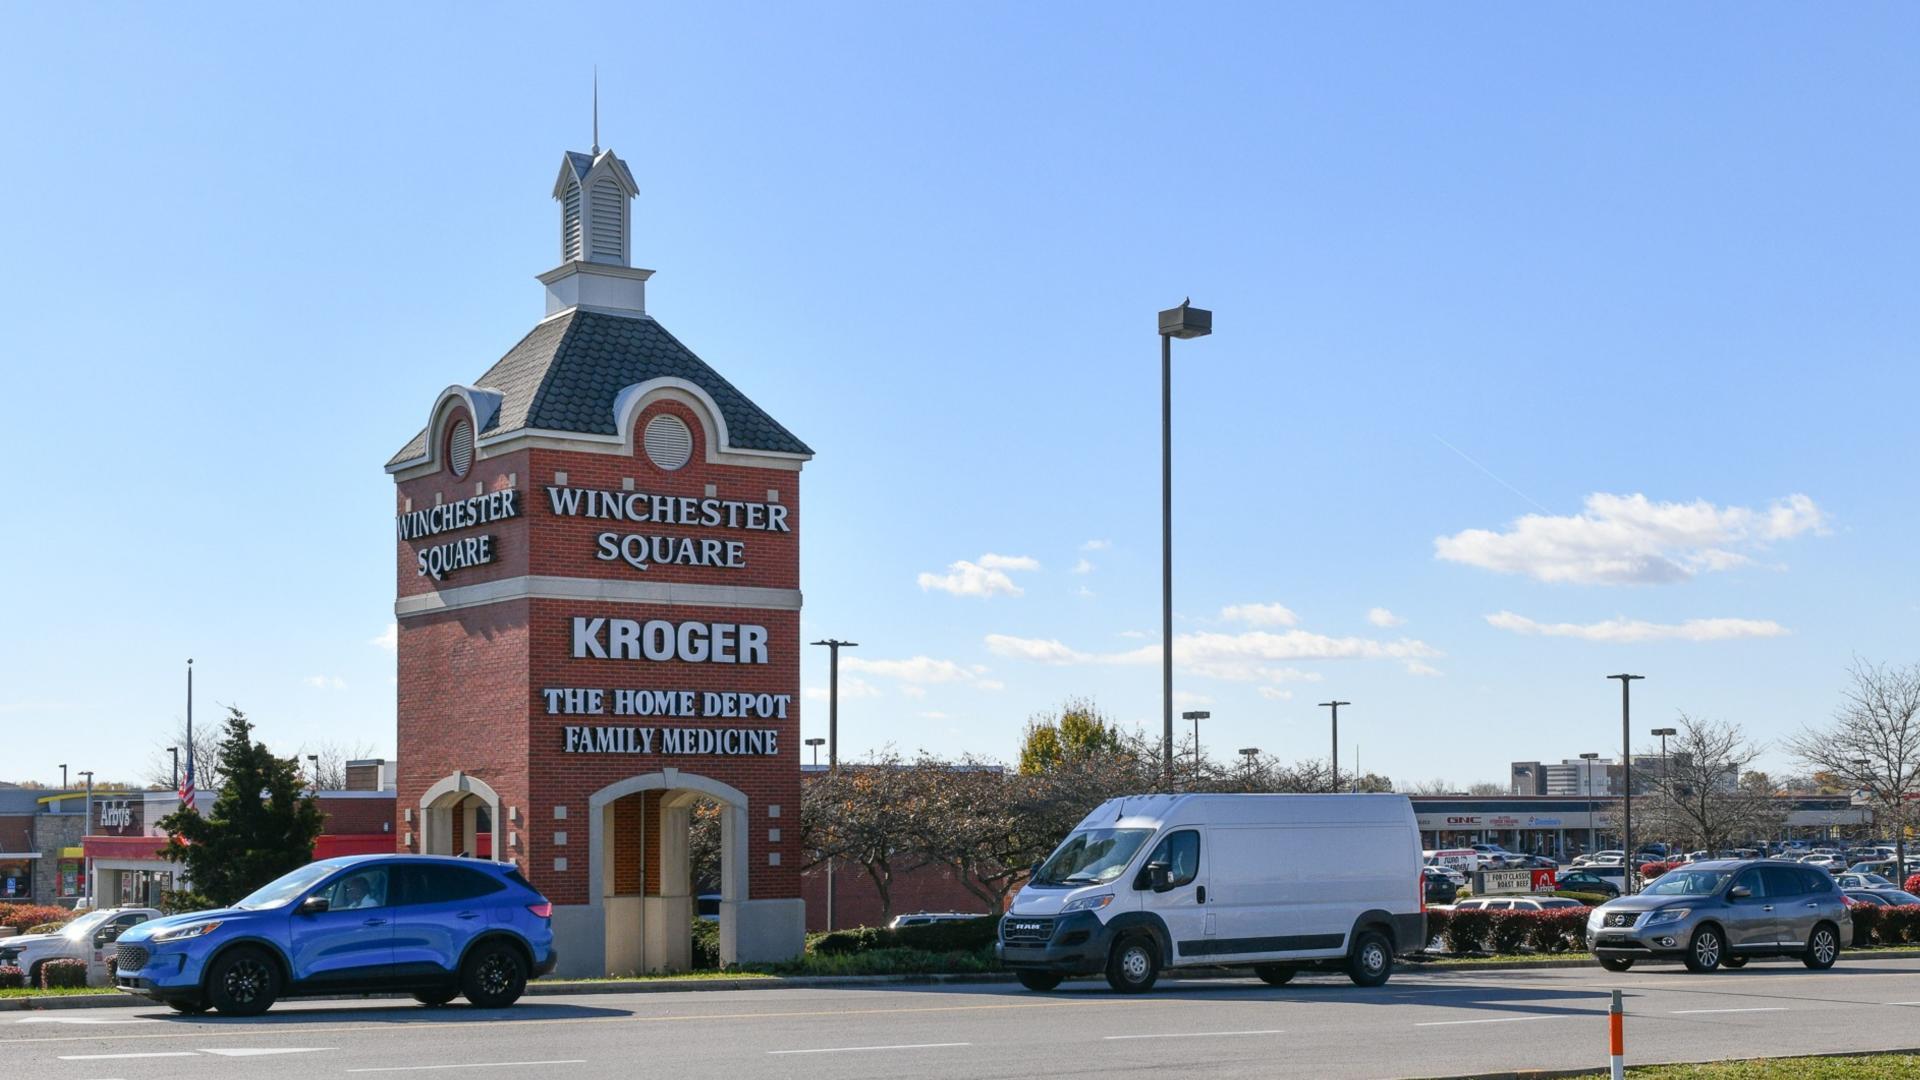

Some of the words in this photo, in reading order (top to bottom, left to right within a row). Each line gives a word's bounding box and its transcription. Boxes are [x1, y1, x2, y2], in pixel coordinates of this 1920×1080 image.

[397, 488, 515, 541] WINCHESTER
[546, 486, 791, 533] WINCHESTER
[417, 535, 491, 581] SQUARE
[597, 532, 746, 570] SQUARE
[572, 616, 769, 664] KROGER
[543, 688, 604, 715] THE
[614, 690, 696, 717] HOME
[703, 692, 791, 720] DEPOT
[564, 726, 655, 754] FAMILY
[662, 728, 778, 756] MEDICINE
[100, 799, 130, 834] Arby's
[1446, 816, 1482, 825] GNC
[1497, 880, 1514, 888] ROAST
[1516, 880, 1529, 888] BEEF
[1509, 872, 1530, 880] CLASSIC
